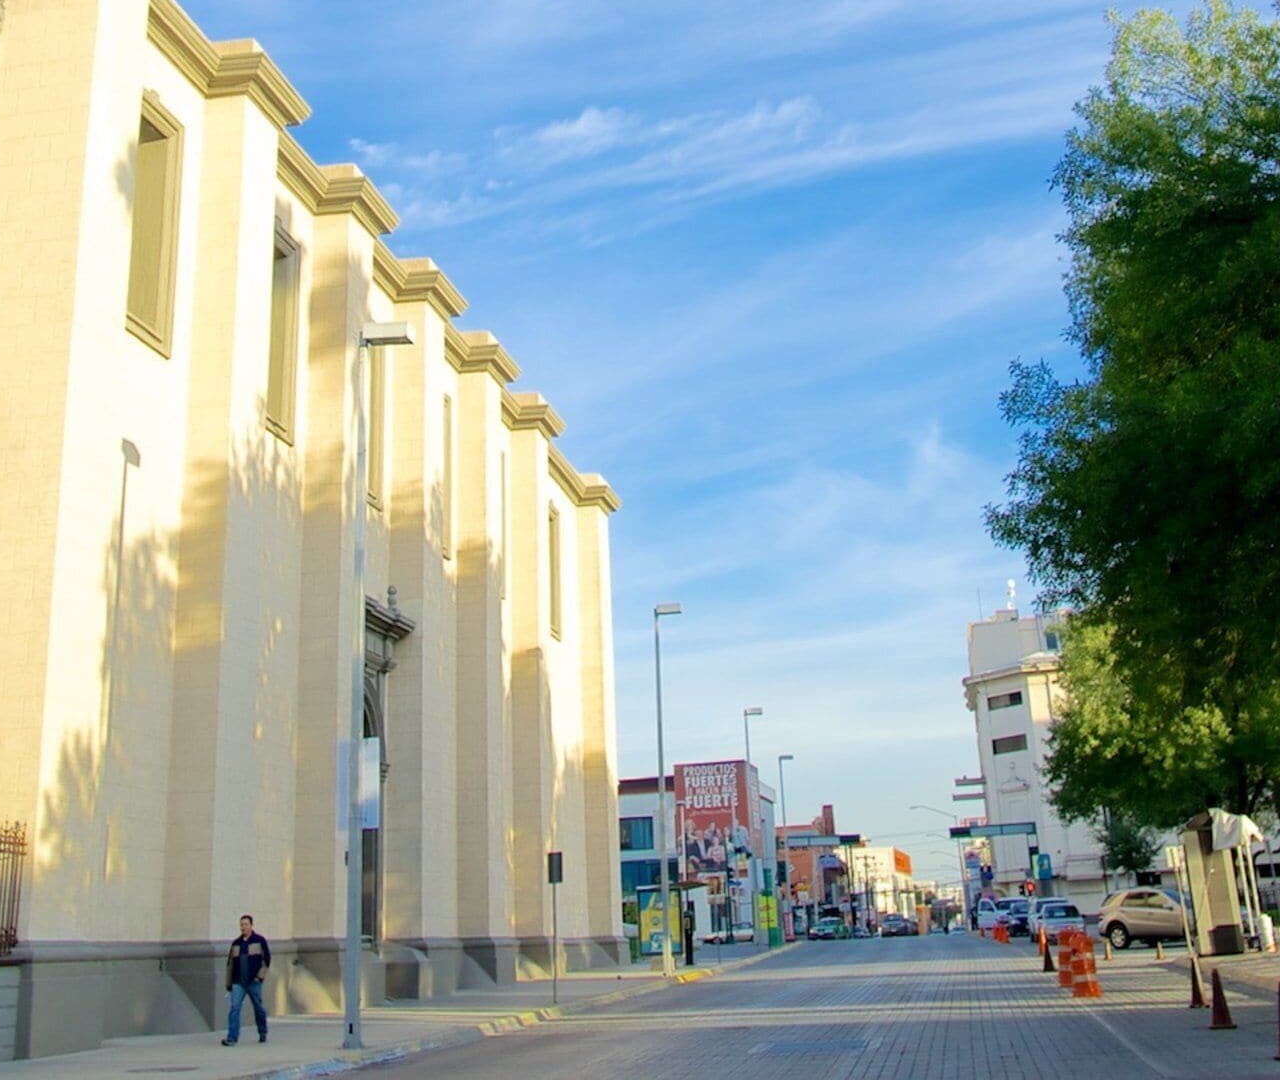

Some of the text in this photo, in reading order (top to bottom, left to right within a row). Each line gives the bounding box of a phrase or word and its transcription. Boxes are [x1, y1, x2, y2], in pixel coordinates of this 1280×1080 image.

[683, 763, 737, 777] PRODUCTOS
[684, 774, 737, 789] FUERTES
[684, 793, 739, 810] FUERTE
